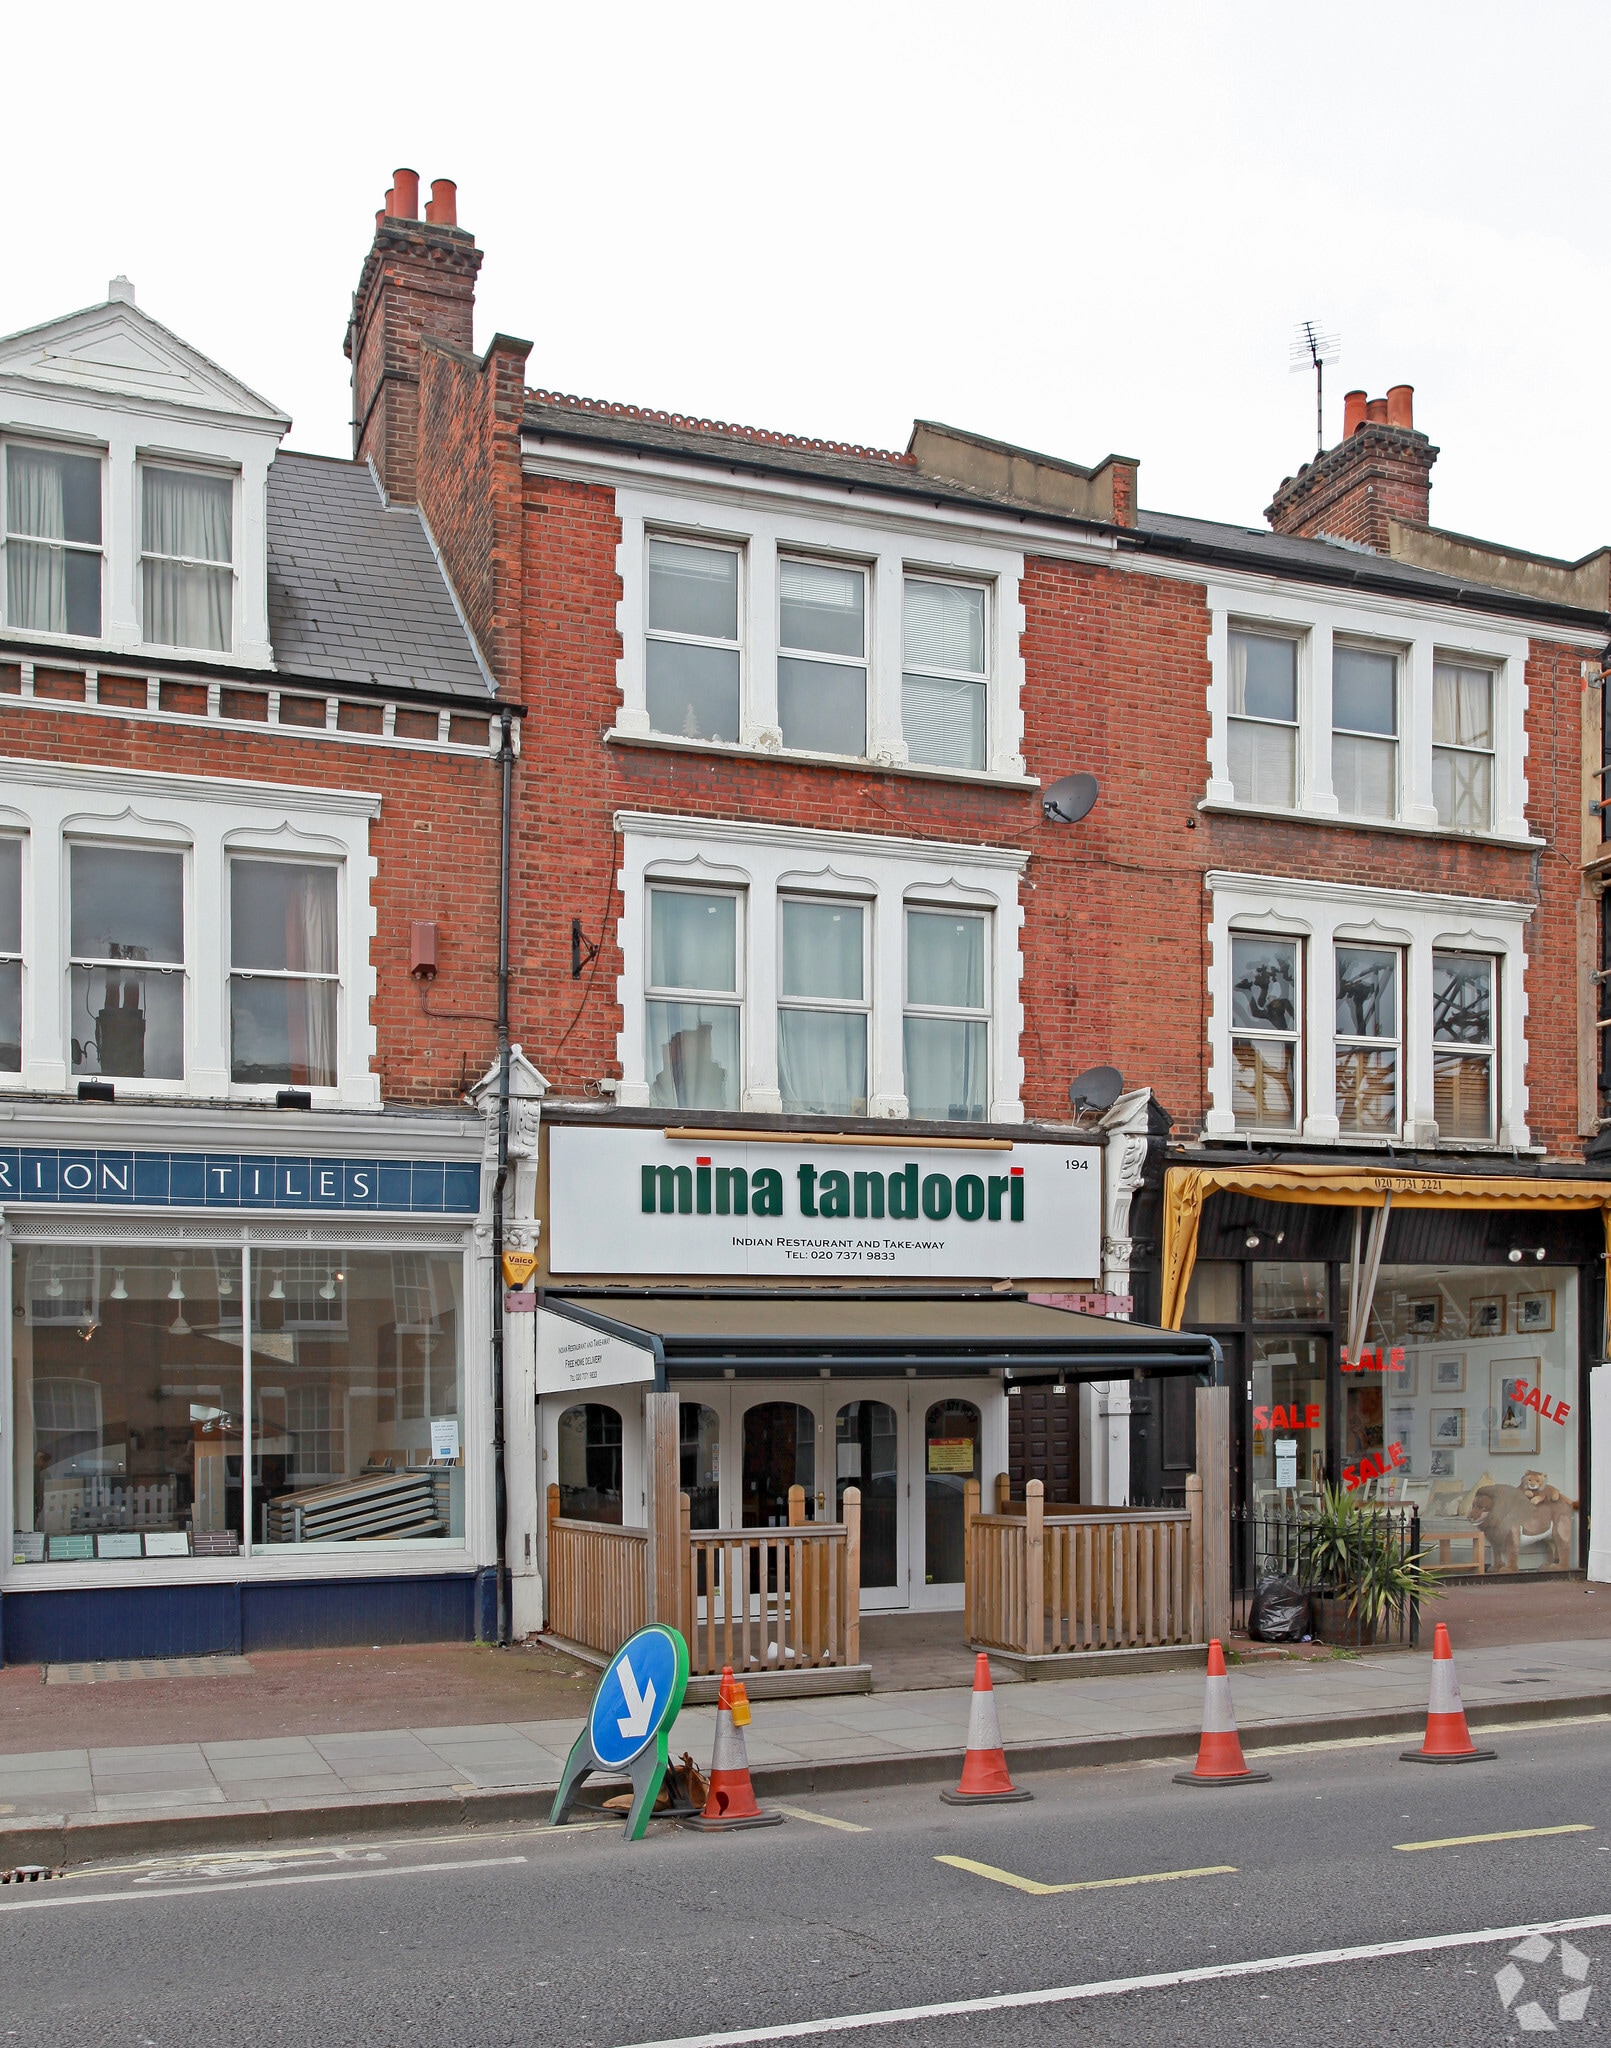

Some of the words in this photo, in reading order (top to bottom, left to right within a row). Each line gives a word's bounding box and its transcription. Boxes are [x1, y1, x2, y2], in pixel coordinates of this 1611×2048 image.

[1066, 1159, 1089, 1170] 194
[211, 1168, 370, 1199] TILES
[642, 1157, 783, 1217] mina
[797, 1163, 1025, 1222] tandoori
[1375, 1177, 1392, 1189] 020
[1396, 1178, 1417, 1190] 7731
[1421, 1179, 1442, 1190] 2221
[810, 1250, 834, 1260] 020
[836, 1251, 863, 1260] 7371
[866, 1251, 896, 1261] 9833
[1510, 1379, 1571, 1426] SALE
[1253, 1404, 1320, 1430] SALE
[1342, 1441, 1407, 1491] SALE
